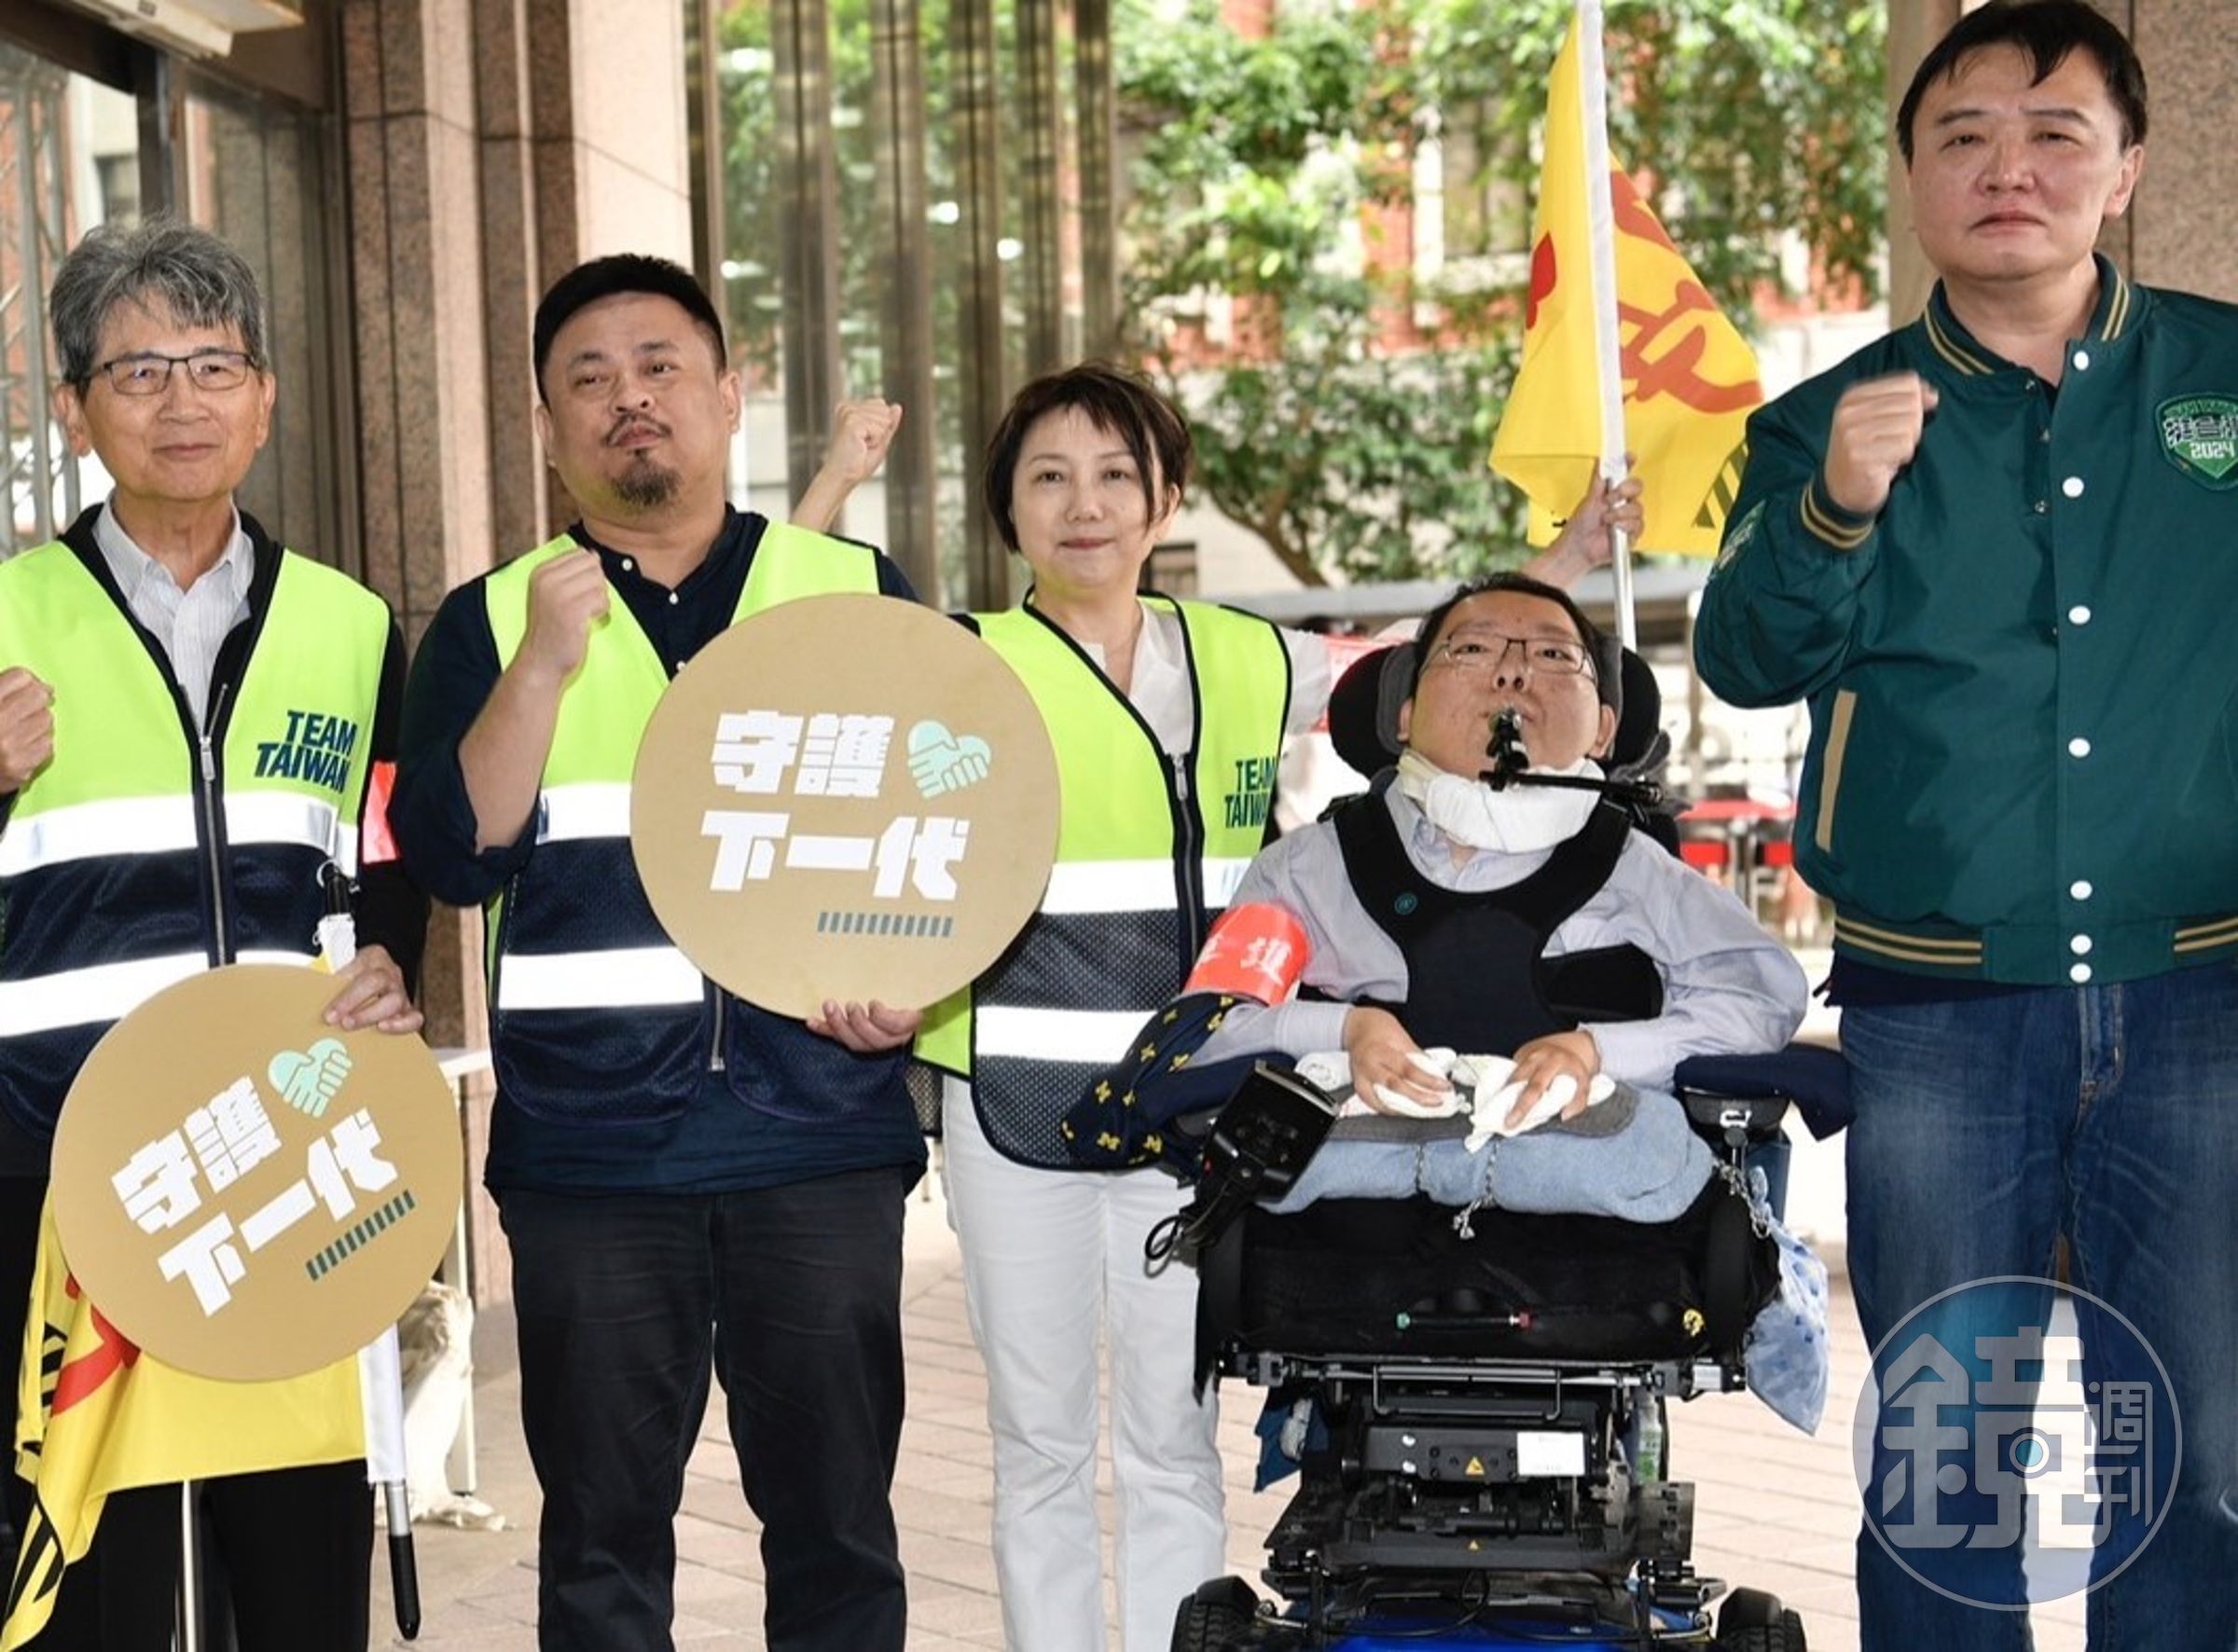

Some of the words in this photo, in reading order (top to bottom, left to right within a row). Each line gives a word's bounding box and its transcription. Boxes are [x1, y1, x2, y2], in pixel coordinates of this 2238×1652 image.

[2189, 440, 2236, 460] 2024
[254, 742, 352, 794] TAIWAN
[285, 709, 358, 757] TEAM
[711, 710, 895, 798] 守護
[700, 810, 971, 901] 下一代
[111, 1075, 283, 1235] 守護
[157, 1107, 398, 1317] 下一代
